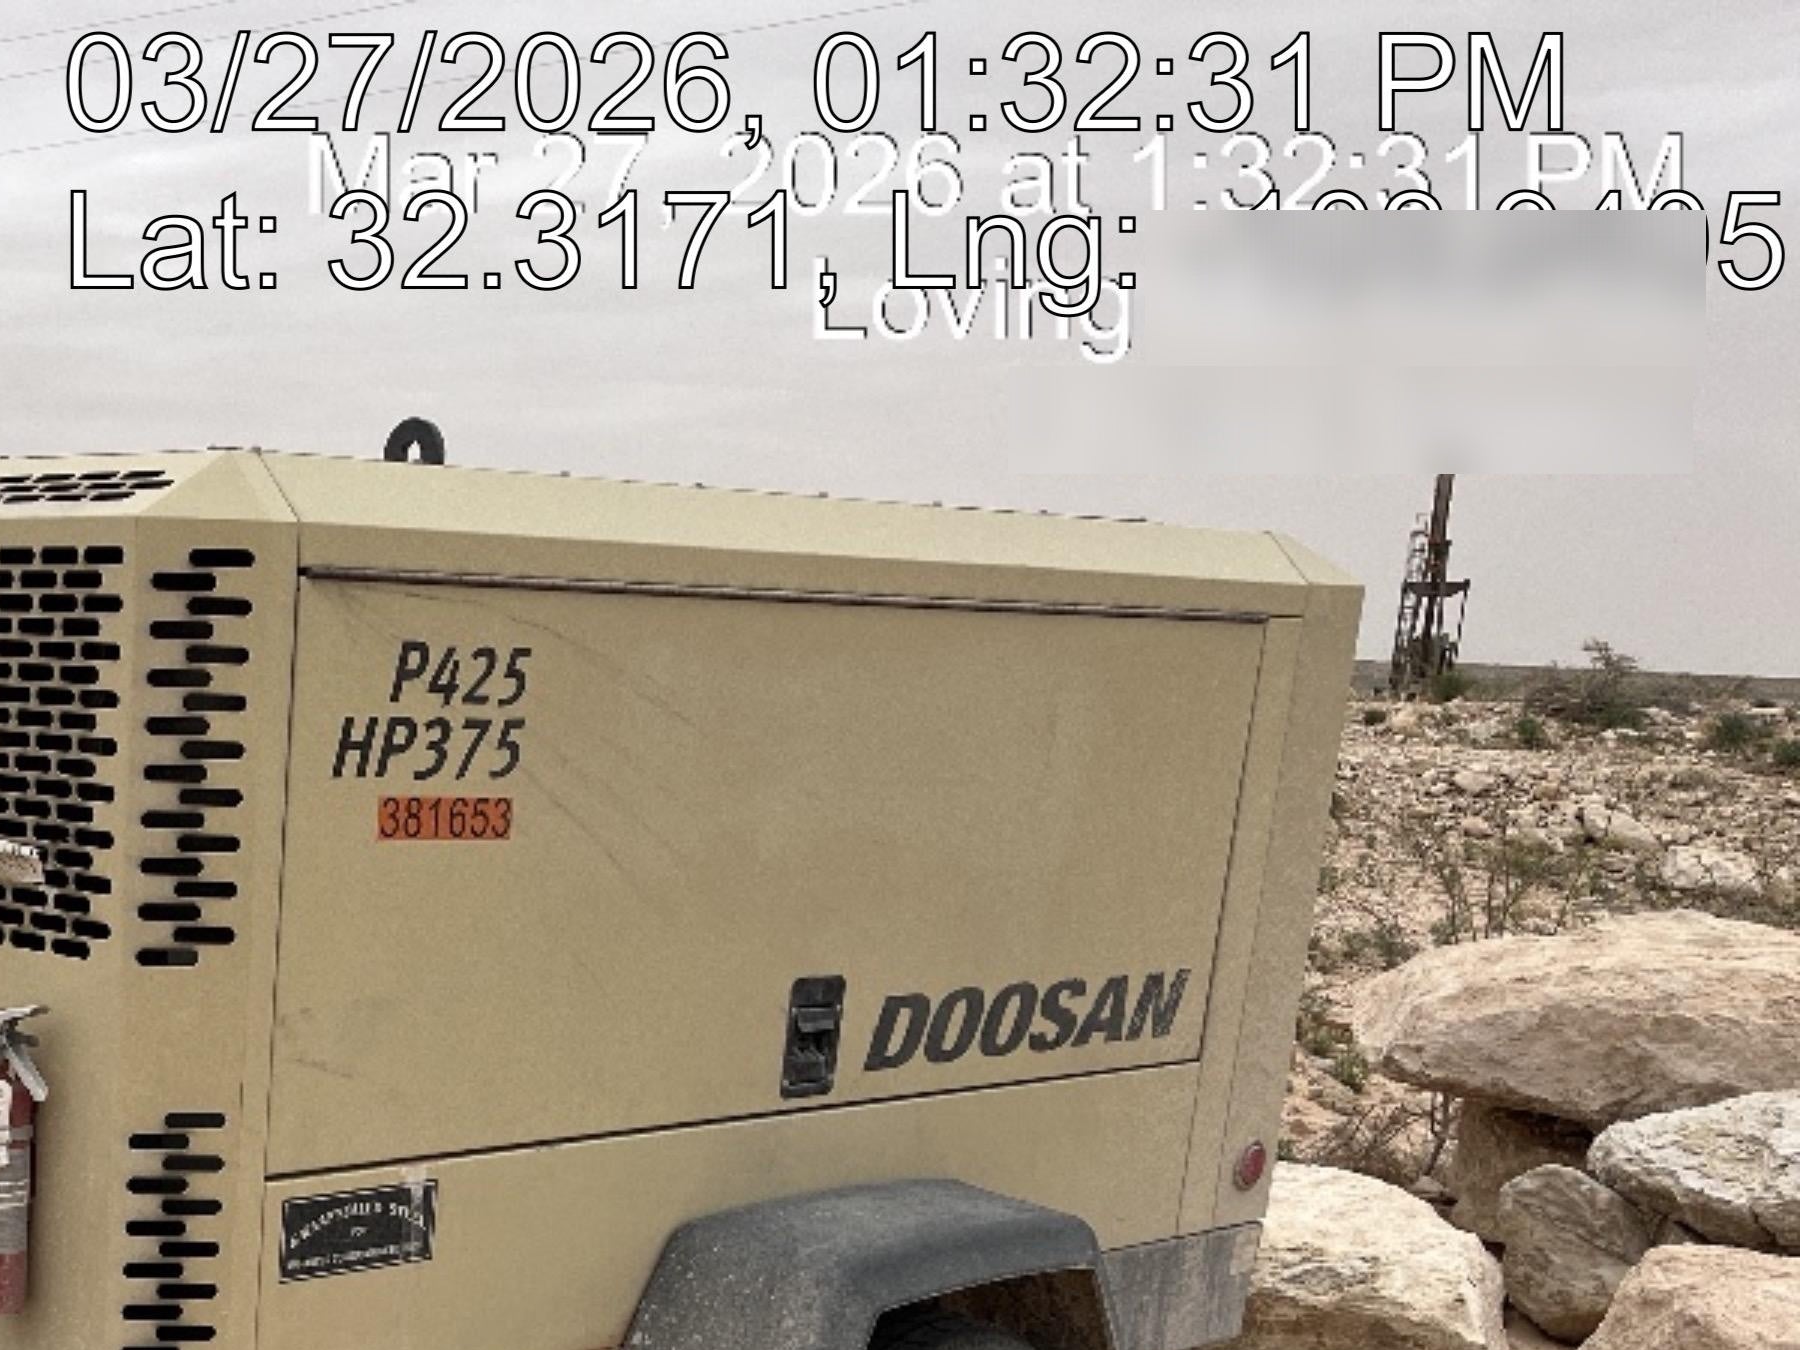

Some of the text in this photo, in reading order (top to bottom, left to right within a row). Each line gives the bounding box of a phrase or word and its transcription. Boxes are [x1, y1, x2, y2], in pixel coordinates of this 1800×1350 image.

[389, 640, 533, 706] P425
[332, 716, 526, 780] HP375
[378, 797, 511, 838] 381653
[862, 967, 1192, 1073] DOOSAN
